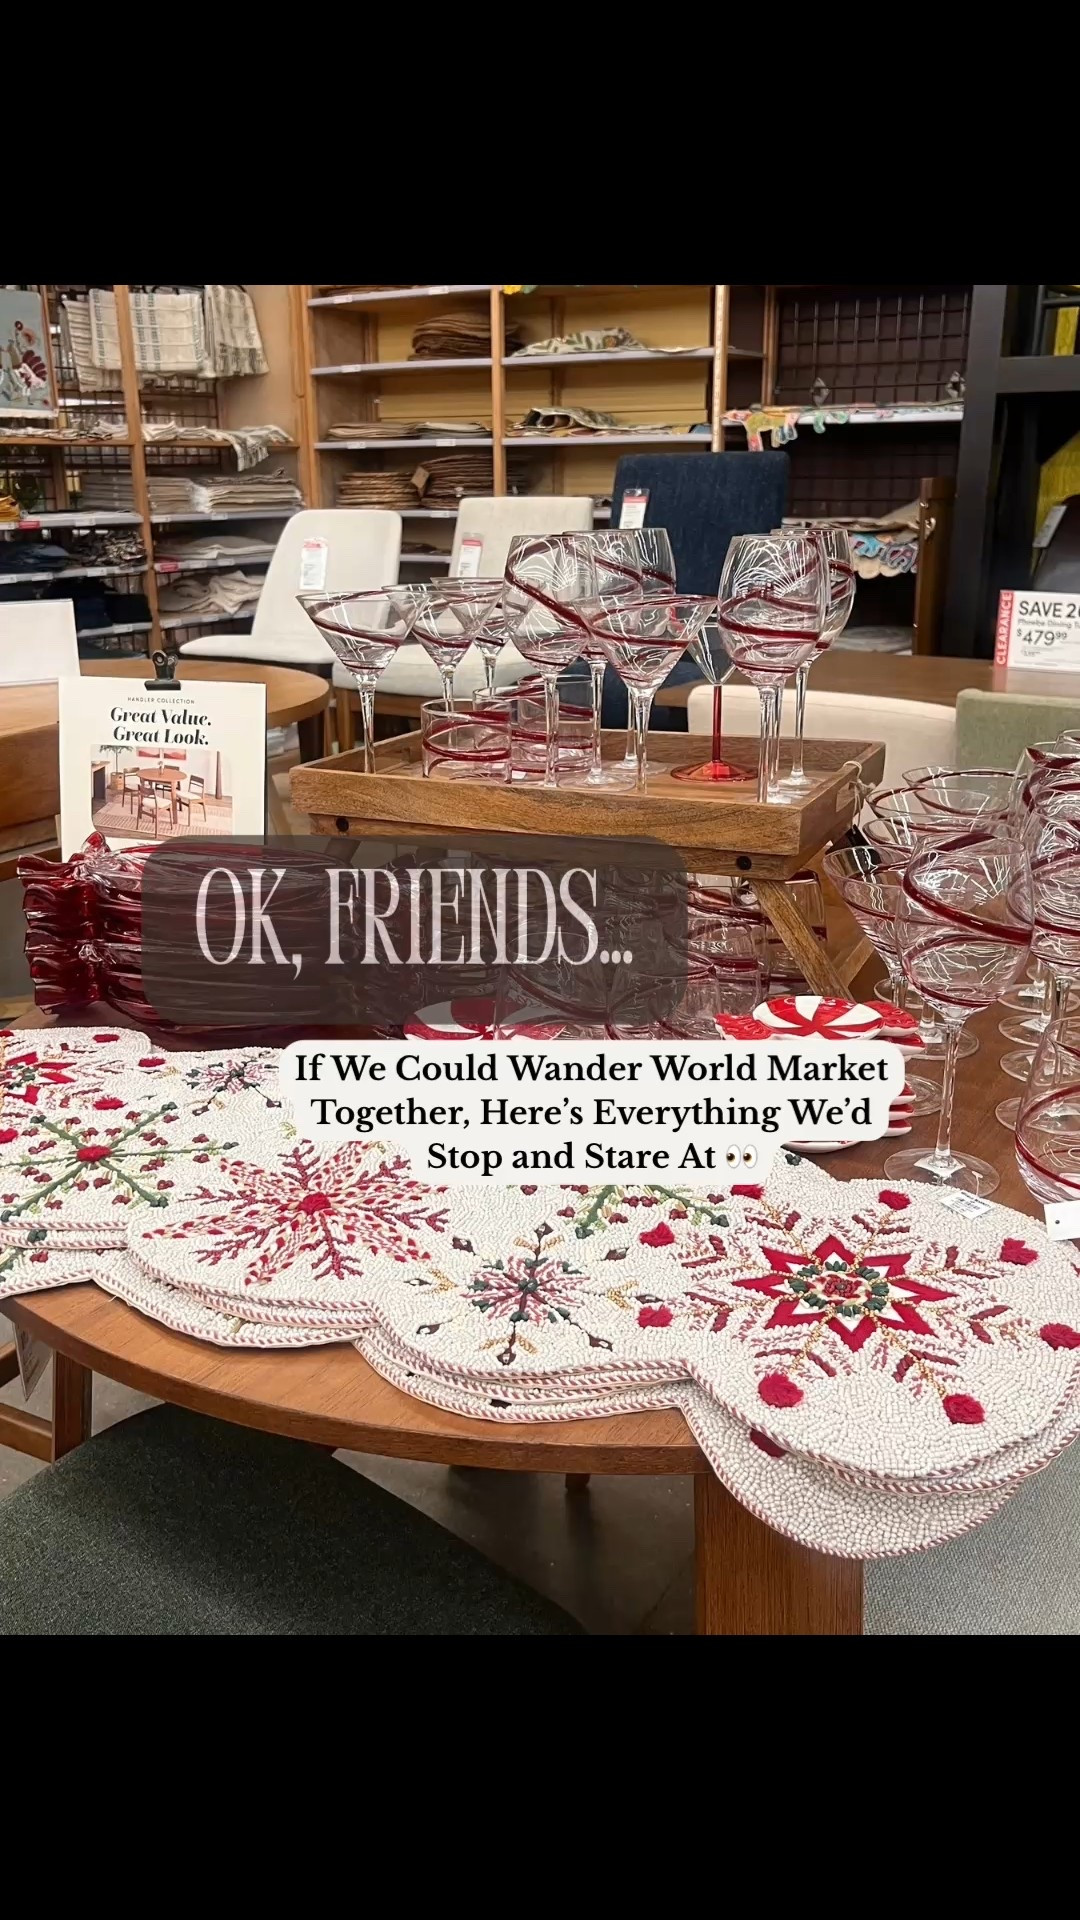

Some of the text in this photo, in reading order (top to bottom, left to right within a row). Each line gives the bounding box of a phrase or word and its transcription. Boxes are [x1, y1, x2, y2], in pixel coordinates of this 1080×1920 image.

[1019, 600, 1080, 619] SAVE 2
[996, 592, 1013, 665] CLEARANCE
[156, 697, 195, 705] COLLECTION
[110, 706, 211, 726] Great Value.
[113, 725, 209, 745] Great Look.
